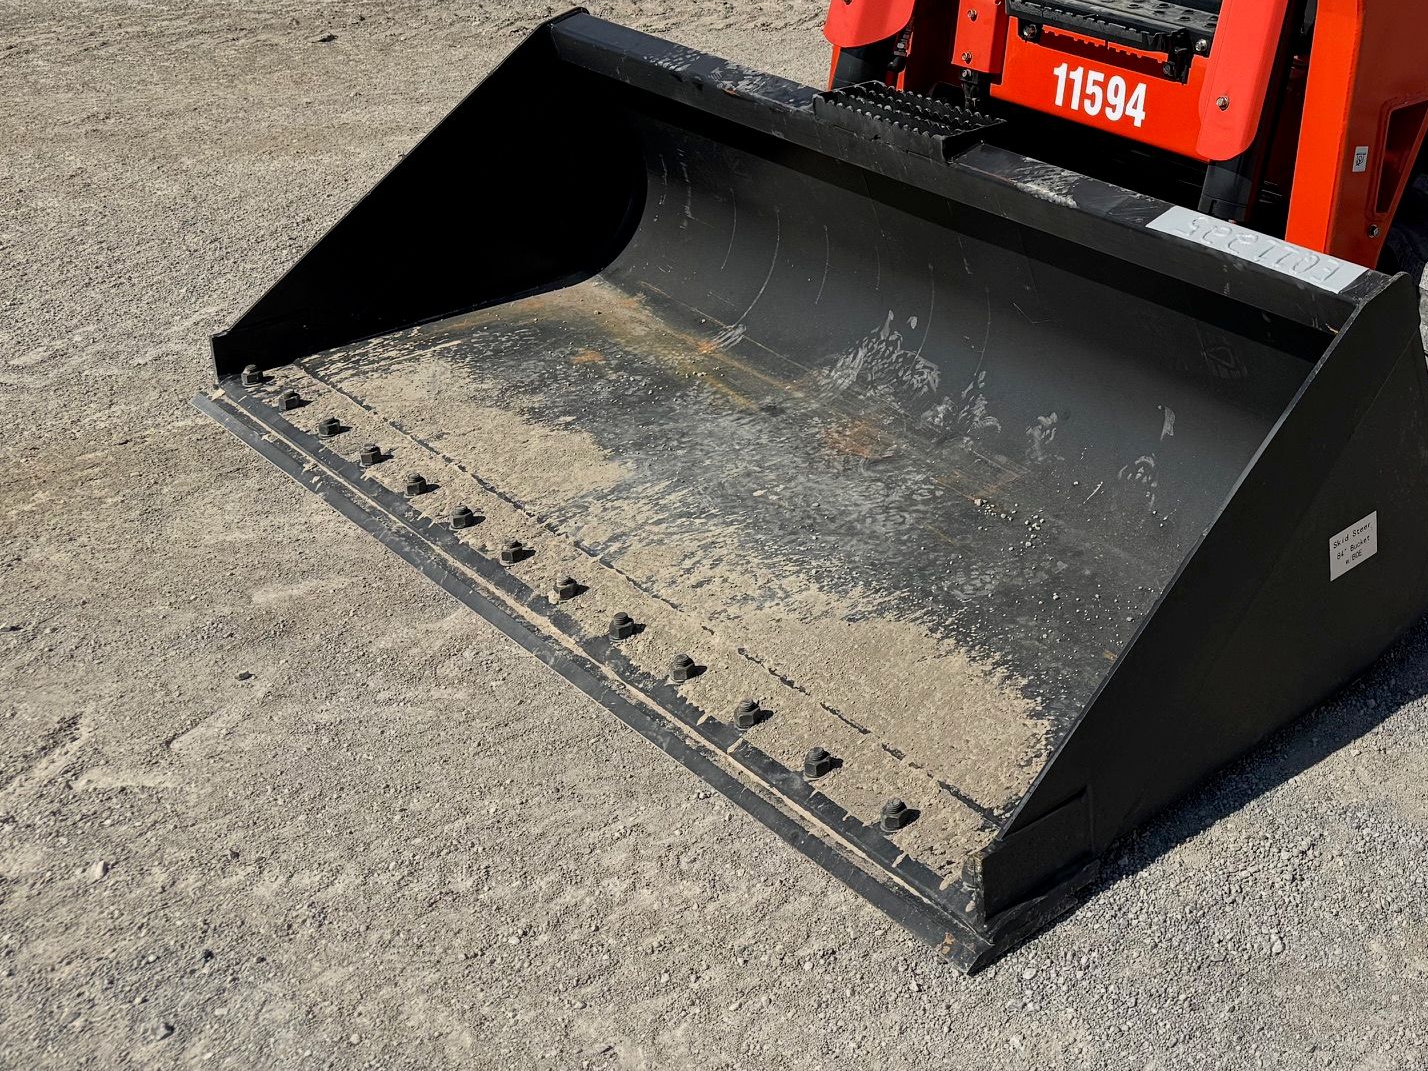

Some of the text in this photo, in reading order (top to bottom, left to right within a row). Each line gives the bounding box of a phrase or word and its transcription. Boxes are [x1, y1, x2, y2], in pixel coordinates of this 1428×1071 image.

[1053, 62, 1148, 128] 11594
[1333, 522, 1371, 549] Skid Steer
